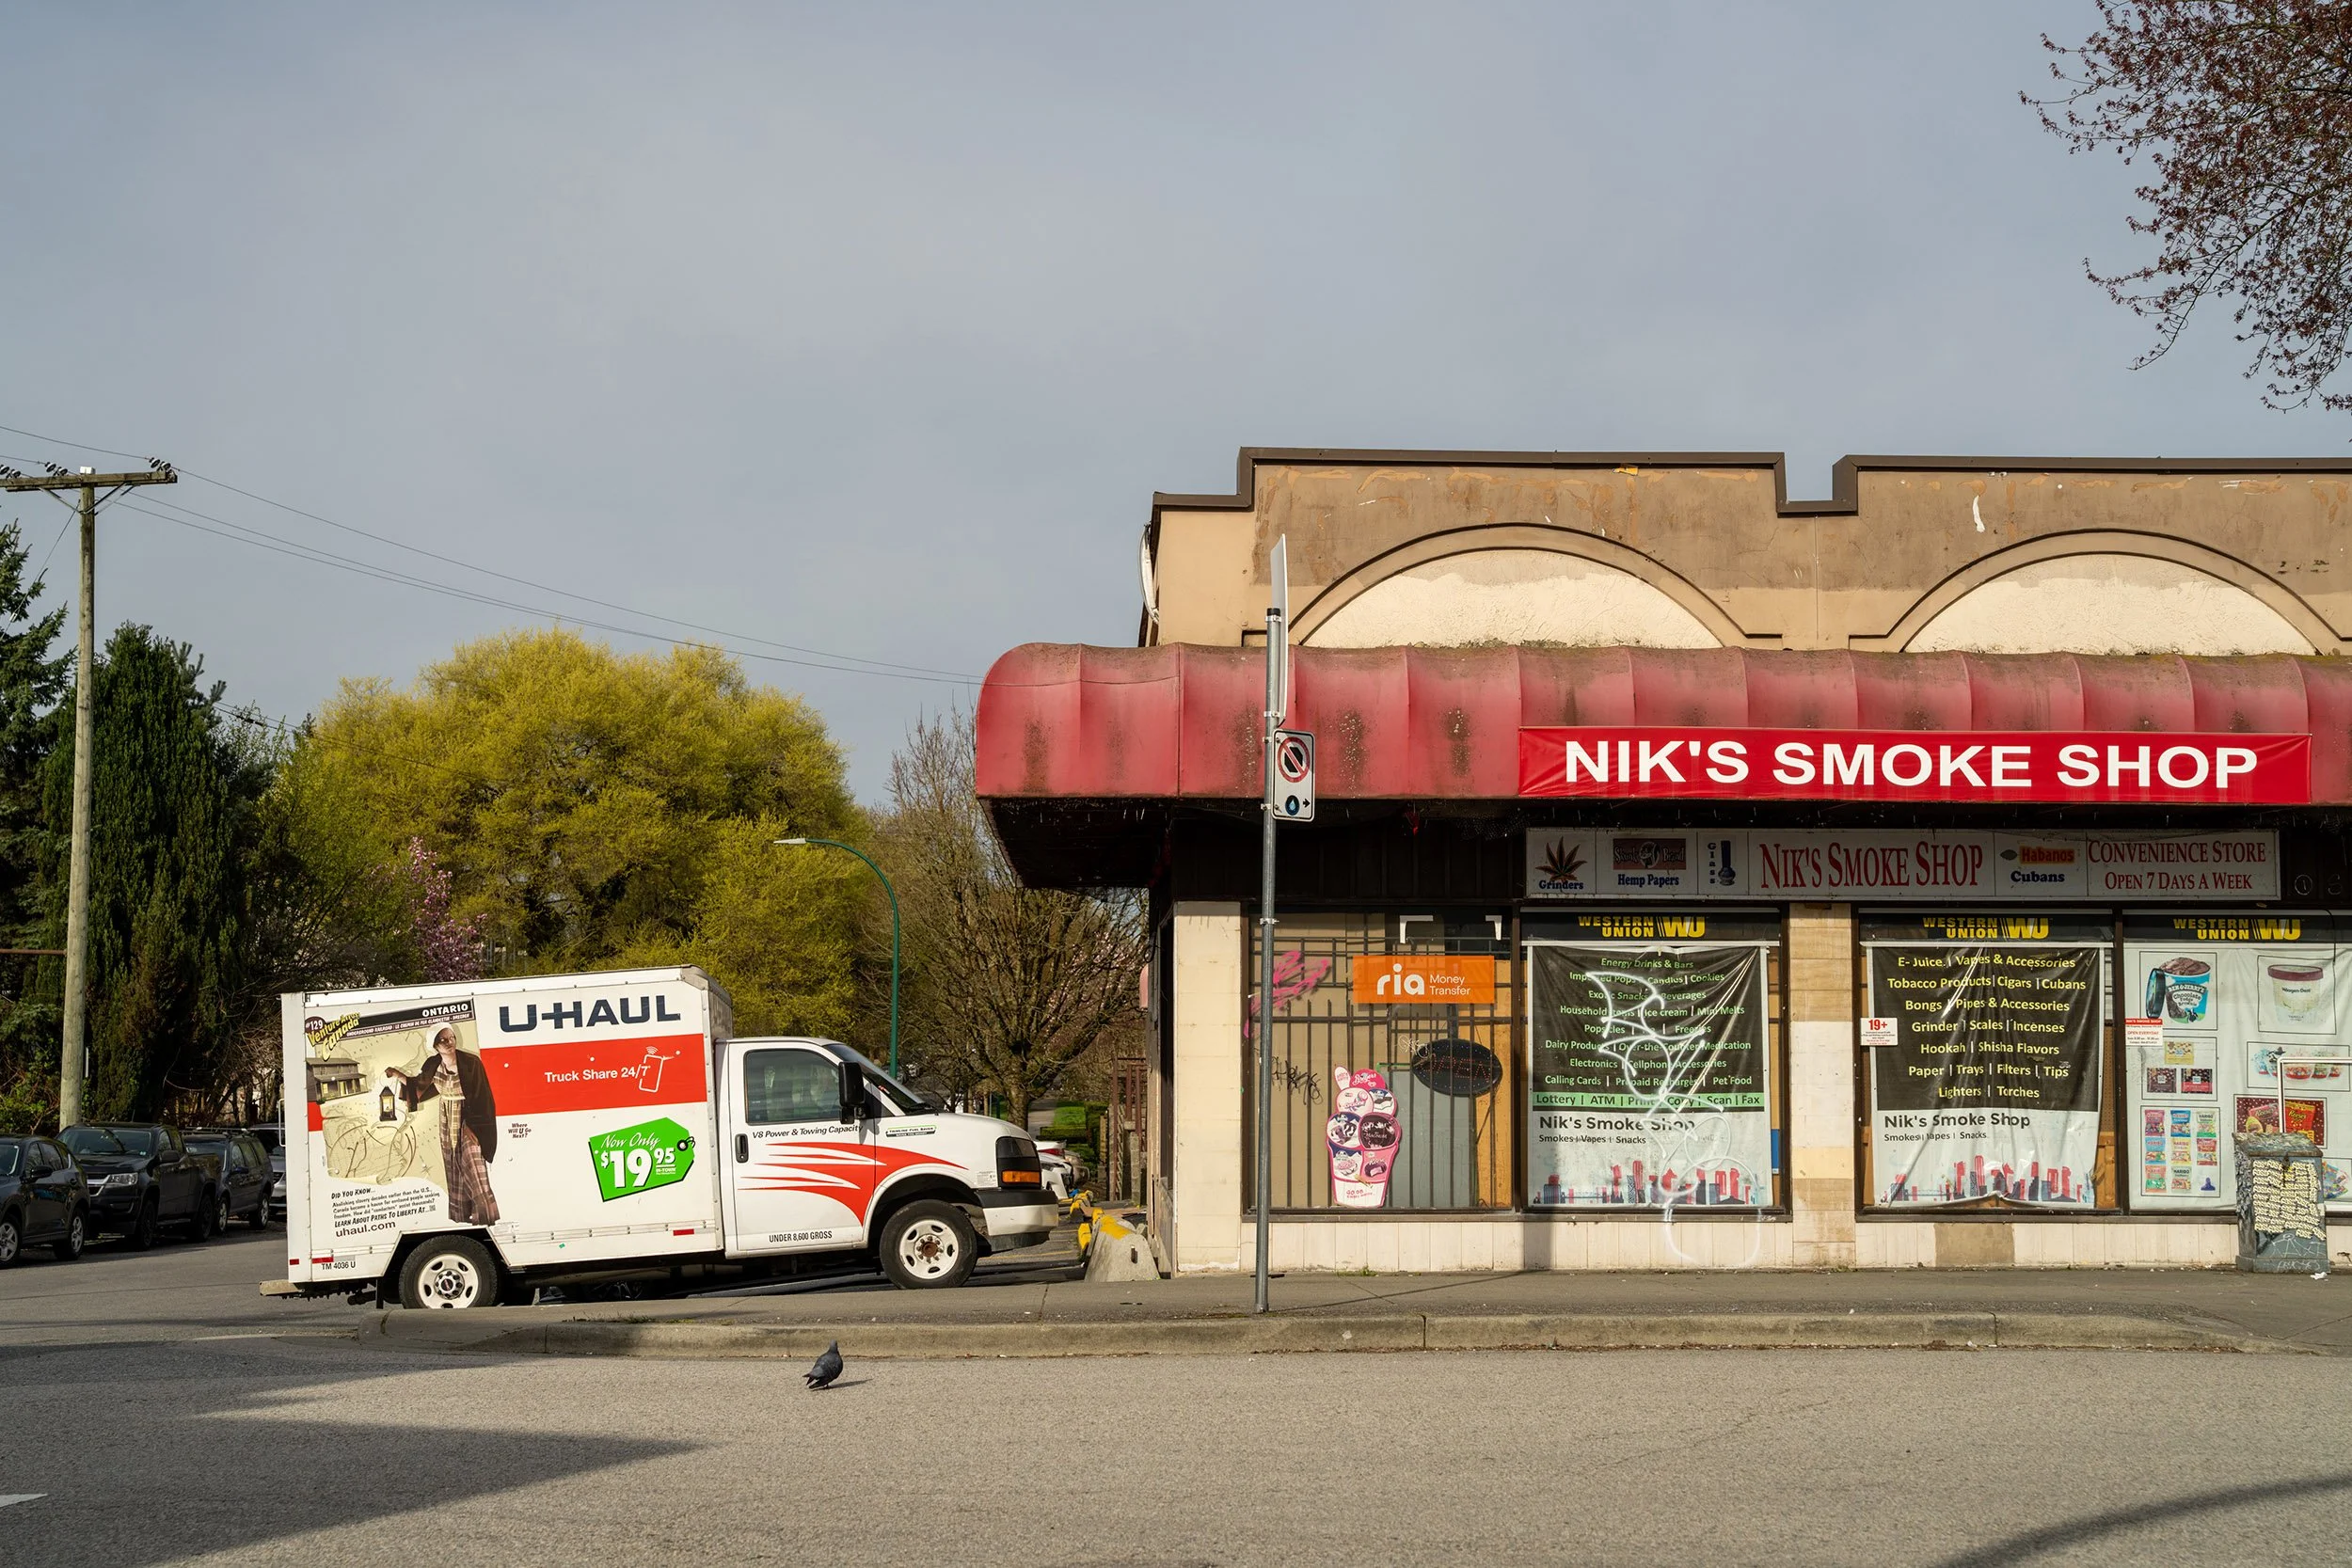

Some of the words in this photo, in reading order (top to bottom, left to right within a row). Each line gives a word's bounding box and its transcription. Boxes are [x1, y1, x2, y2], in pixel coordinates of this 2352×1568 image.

[1565, 740, 1749, 784] NIK'S
[1772, 741, 2032, 786] SMOKE
[2057, 744, 2259, 789] SHOP
[2022, 847, 2074, 863] Habanos
[2088, 840, 2209, 863] CONVENIENCE
[2212, 840, 2266, 863] STORE
[1708, 842, 1716, 885] Glass
[1760, 843, 1822, 889] NIK'S
[1827, 841, 1910, 887] SMOKE
[1915, 843, 1983, 887] SHOP
[1617, 874, 1645, 888] Hemp
[1647, 874, 1679, 888] Papers
[2010, 870, 2065, 883] Cubans
[2105, 871, 2143, 890] OPEN
[2146, 872, 2155, 890] 7
[2158, 871, 2195, 890] DAYS
[2195, 872, 2208, 890] A
[2212, 872, 2253, 890] WEEK
[1538, 879, 1584, 891] Grinders
[1578, 916, 1654, 927] WESTERN
[1923, 917, 1998, 927] WESTERN
[2173, 918, 2249, 929] WESTERN
[1602, 927, 1654, 938] UNION
[1947, 928, 1998, 939] UNION
[2197, 929, 2249, 940] UNION
[1601, 958, 1632, 969] Energy
[1634, 959, 1662, 968] Drinks
[1664, 959, 1672, 968] &
[1955, 956, 1990, 968] Vapes
[1993, 954, 2003, 965] &
[2006, 956, 2076, 968] Accessories
[1376, 963, 1425, 995] ria
[1429, 974, 1465, 986] Money
[1690, 974, 1724, 982] Cookies
[1887, 977, 1936, 989] Tobacco
[1940, 975, 1992, 989] Products
[1997, 975, 2032, 989] Cigars
[2042, 978, 2087, 990] Cubans
[1429, 985, 1470, 996] Transfer
[1617, 991, 1648, 1000] Snacks
[1661, 991, 1707, 1001] Beverages
[422, 1003, 469, 1018] ONTARIO
[1560, 1005, 1608, 1016] Household
[1661, 1008, 1688, 1017] cream
[1720, 1006, 1745, 1015] Melts
[1905, 1000, 1943, 1012] Bongs
[1955, 998, 1985, 1011] Pipes
[1988, 997, 1997, 1008] &
[2000, 998, 2070, 1012] Accessories
[1584, 1024, 1626, 1034] Popscles
[1868, 1019, 1888, 1031] 19+
[1912, 1022, 1959, 1032] Grinder
[1969, 1019, 2003, 1031] Scales
[2012, 1021, 2065, 1033] Incenses
[308, 1019, 341, 1047] Venture
[322, 1018, 359, 1061] Canada
[1545, 1039, 1569, 1051] Dairy
[1702, 1040, 1751, 1051] Medication
[1920, 1042, 1966, 1053] Hookah
[1978, 1041, 2013, 1053] Shisha
[2016, 1043, 2060, 1054] Flavors
[1569, 1058, 1618, 1069] Electronics
[545, 1069, 580, 1084] Truck
[582, 1067, 618, 1080] Share
[621, 1064, 648, 1080] 24/7
[1908, 1066, 1945, 1077] Paper
[1956, 1064, 1984, 1076] Trays
[1996, 1064, 2031, 1076] Filters
[2042, 1066, 2069, 1078] Tips
[1545, 1075, 1575, 1085] Calling
[1577, 1076, 1601, 1085] Cards
[1712, 1076, 1728, 1085] Pet
[1730, 1076, 1753, 1085] Food
[1938, 1086, 1981, 1099] Lighters
[1996, 1085, 2040, 1098] Torches
[1536, 1094, 1576, 1105] Lottery
[1590, 1095, 1615, 1105] ATM
[1707, 1096, 1732, 1105] Scan
[1741, 1095, 1760, 1104] Fax
[1539, 1116, 1582, 1130] Nik's
[1586, 1117, 1643, 1130] Smoke
[1651, 1117, 1694, 1132] Shop
[1884, 1115, 1927, 1128] Nik's
[1932, 1113, 1986, 1126] Smoke
[1991, 1113, 2030, 1129] Shop
[752, 1131, 764, 1139] V8
[765, 1130, 790, 1138] Power
[800, 1127, 827, 1135] Towing
[828, 1124, 863, 1133] Capacity
[1960, 1131, 1987, 1139] Snacks
[600, 1134, 627, 1148] Now
[629, 1132, 660, 1150] Only
[1538, 1134, 1573, 1143] Smokes
[1580, 1134, 1607, 1145] Vapes
[1615, 1135, 1646, 1144] Snacks
[334, 1219, 352, 1227] LEARN
[352, 1215, 370, 1225] ABOUT
[370, 1213, 388, 1222] PATHS
[396, 1207, 418, 1217] LIBERTY
[336, 1221, 396, 1238] uhaul.com
[769, 1233, 792, 1243] UNDER
[793, 1232, 809, 1241] 8,600
[809, 1230, 833, 1240] GROSS
